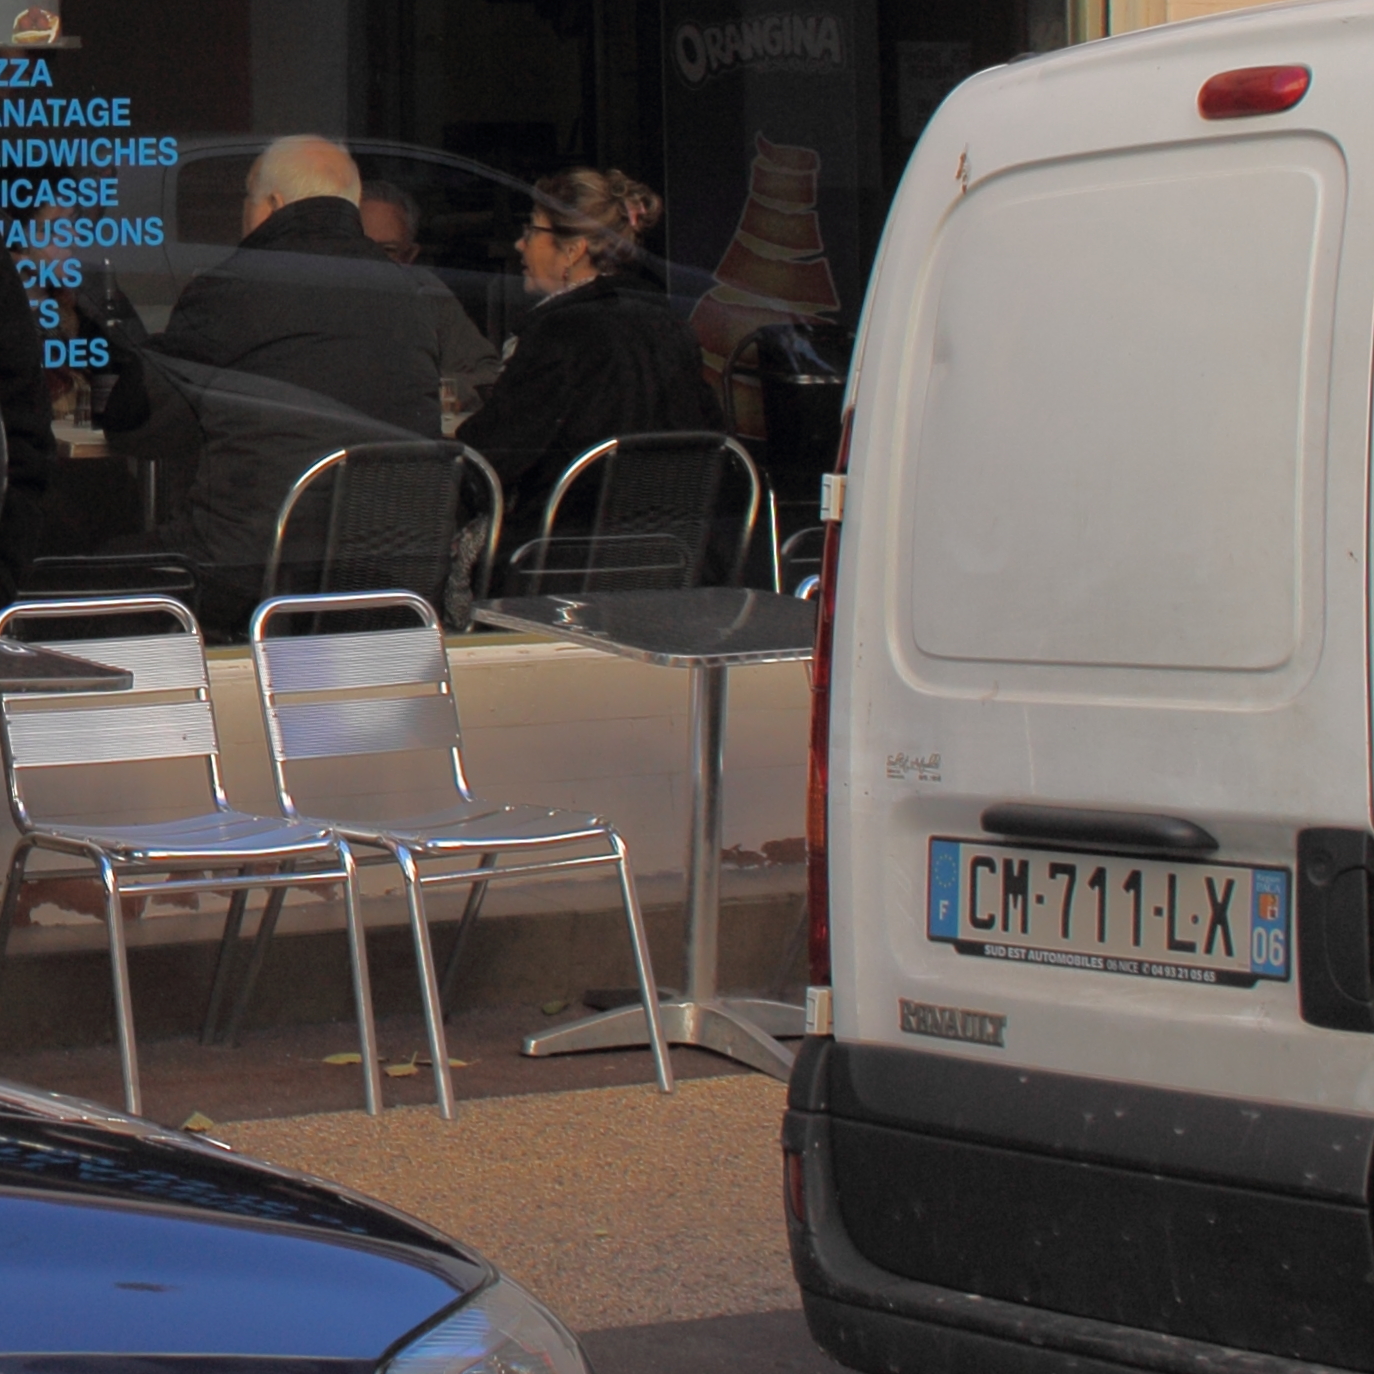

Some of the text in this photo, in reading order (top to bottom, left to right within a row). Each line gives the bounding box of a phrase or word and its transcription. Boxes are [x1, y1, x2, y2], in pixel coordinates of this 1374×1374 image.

[938, 899, 950, 921] F
[983, 944, 1006, 957] SUD
[1007, 947, 1026, 960] EST
[1027, 949, 1104, 970] AUTOMOBILES
[1106, 959, 1118, 971] 06
[1118, 960, 1140, 974] NICE
[1151, 964, 1164, 976] 04
[1164, 966, 1176, 978] 93
[1177, 967, 1189, 979] 21
[1252, 926, 1285, 967] 06
[898, 996, 1008, 1048] RENAULT
